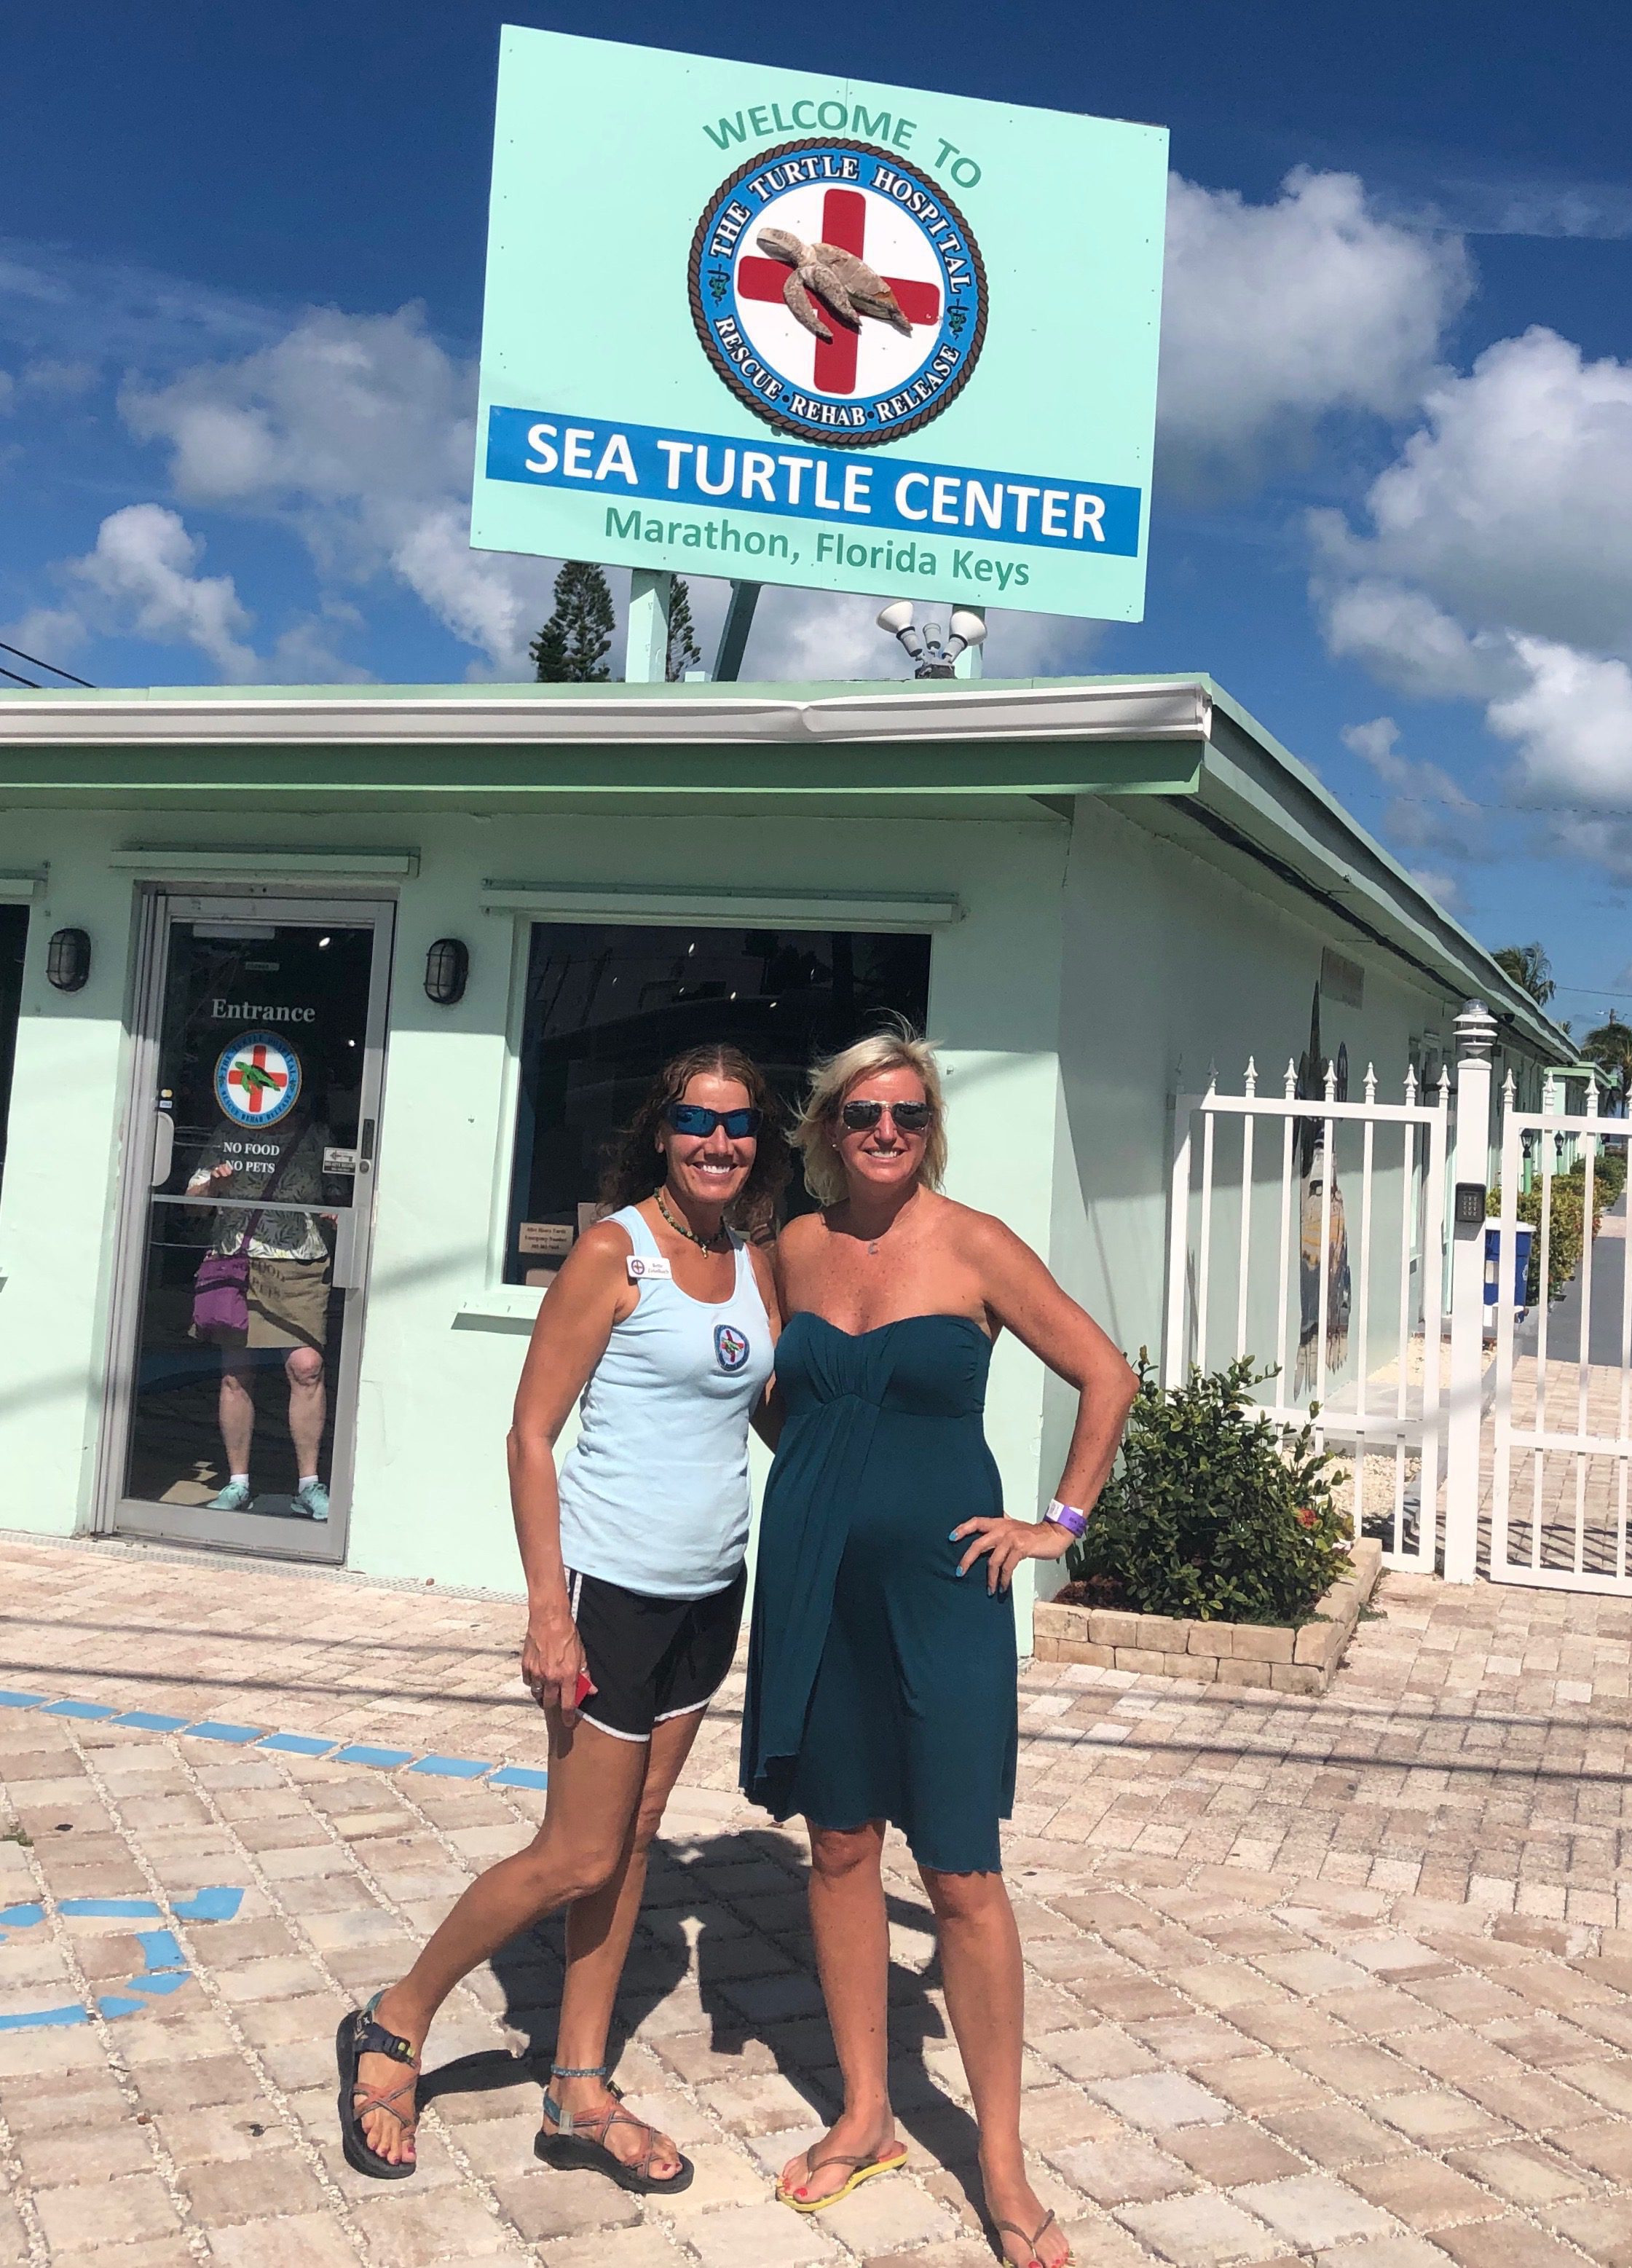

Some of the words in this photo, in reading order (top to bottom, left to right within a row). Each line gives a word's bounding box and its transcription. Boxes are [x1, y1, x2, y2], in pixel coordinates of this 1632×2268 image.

[703, 100, 917, 151] WELCOME
[934, 138, 982, 189] TO
[710, 202, 751, 259] THE
[749, 155, 861, 202] TURTLE
[872, 168, 973, 294] HOSPITAL
[714, 316, 784, 399] RESCUE
[791, 395, 866, 426] REHAB
[876, 344, 960, 422] RELEASE
[524, 423, 639, 485] SEA
[657, 440, 873, 514] TURTLE
[894, 472, 1105, 543] CENTER
[605, 507, 800, 565] Marathon,
[816, 532, 937, 577] Florida
[952, 548, 1030, 591] Keys
[211, 999, 315, 1022] Entrance
[223, 1141, 242, 1154] NO
[245, 1143, 280, 1156] FOOD
[226, 1159, 243, 1171] NO
[245, 1161, 275, 1173] PETS
